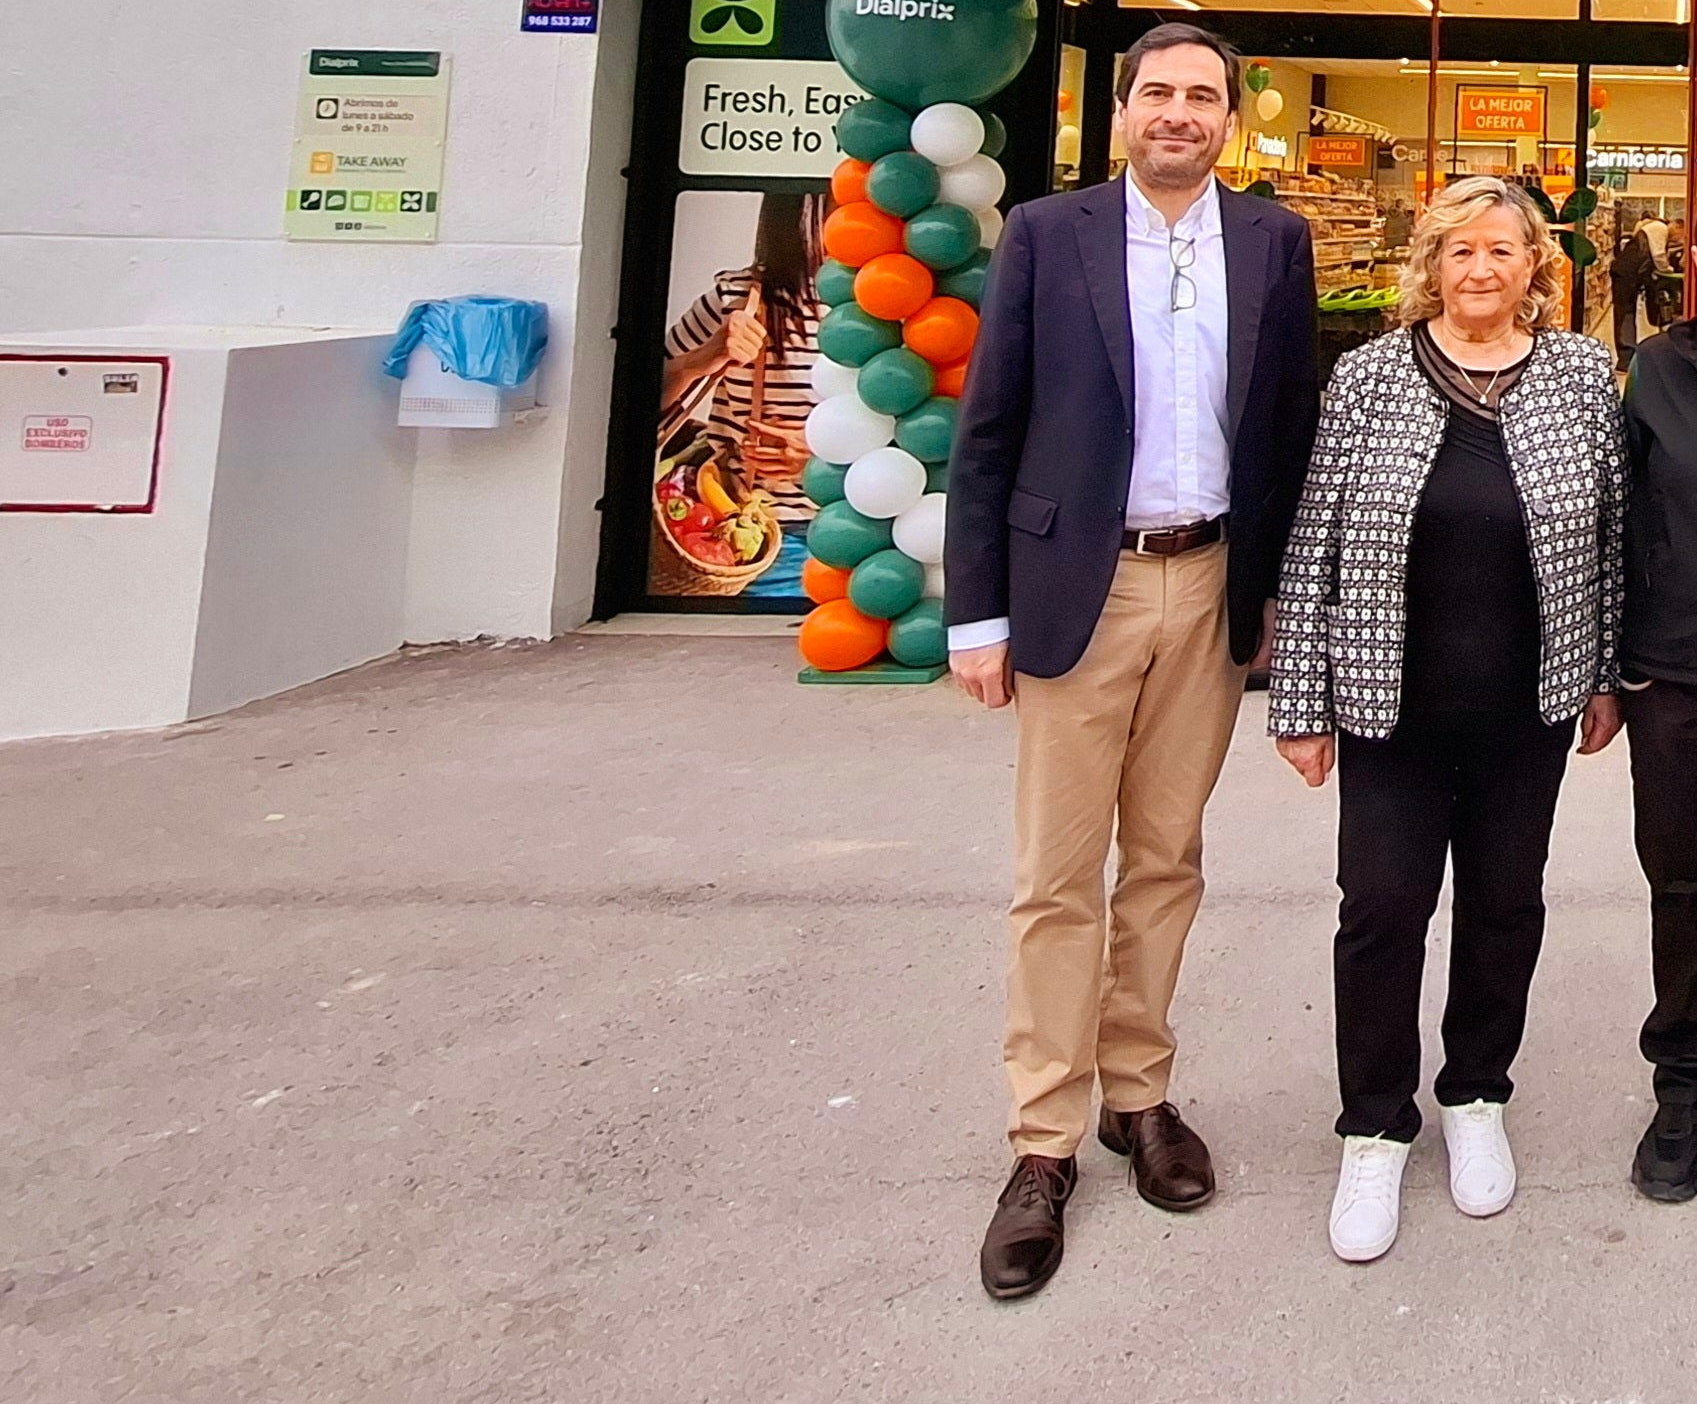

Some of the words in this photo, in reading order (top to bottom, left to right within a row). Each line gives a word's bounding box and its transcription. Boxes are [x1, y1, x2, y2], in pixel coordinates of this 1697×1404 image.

[703, 83, 794, 117] Fresh,
[805, 86, 872, 115] Eas
[1470, 98, 1486, 111] LA
[1489, 98, 1533, 113] MEJOR
[1476, 115, 1525, 130] OFERTA
[701, 121, 783, 152] Close
[792, 125, 823, 153] to
[1329, 141, 1358, 151] MEJOR
[336, 155, 369, 167] TAKE
[370, 156, 408, 167] AWAY
[1320, 153, 1353, 162] OFERTA
